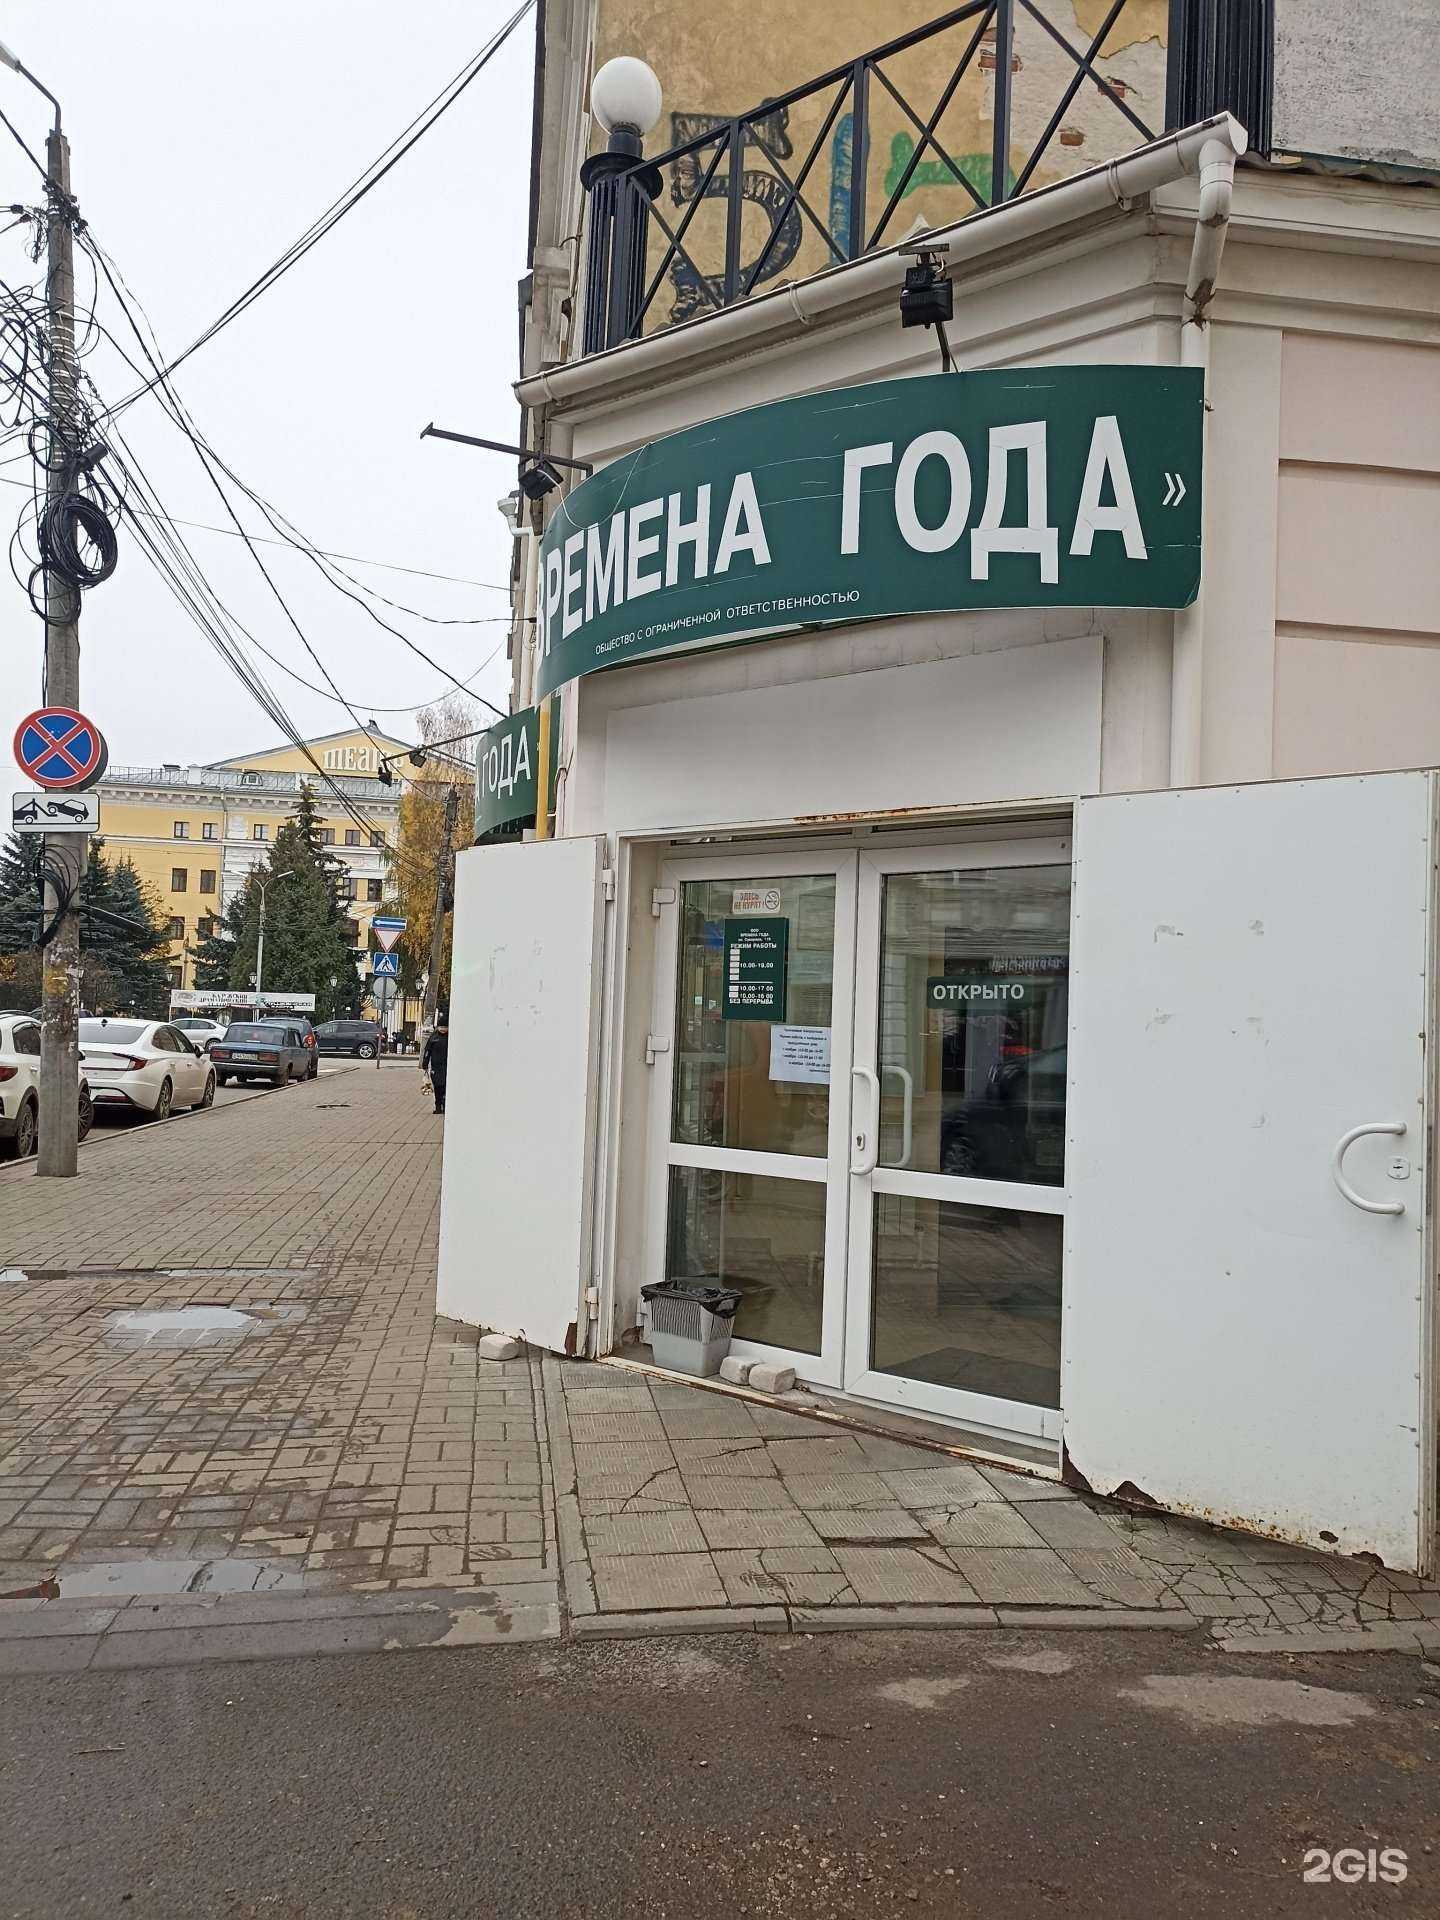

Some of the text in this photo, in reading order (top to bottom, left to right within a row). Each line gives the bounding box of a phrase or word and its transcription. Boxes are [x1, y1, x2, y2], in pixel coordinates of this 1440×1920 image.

[595, 590, 860, 655] ОБЩЕСТВО С ОГРАНИЧЕННОЙ ОТВЕТСТВЕННОСТЬЮ
[933, 984, 1025, 1000] ОТКРЫТО
